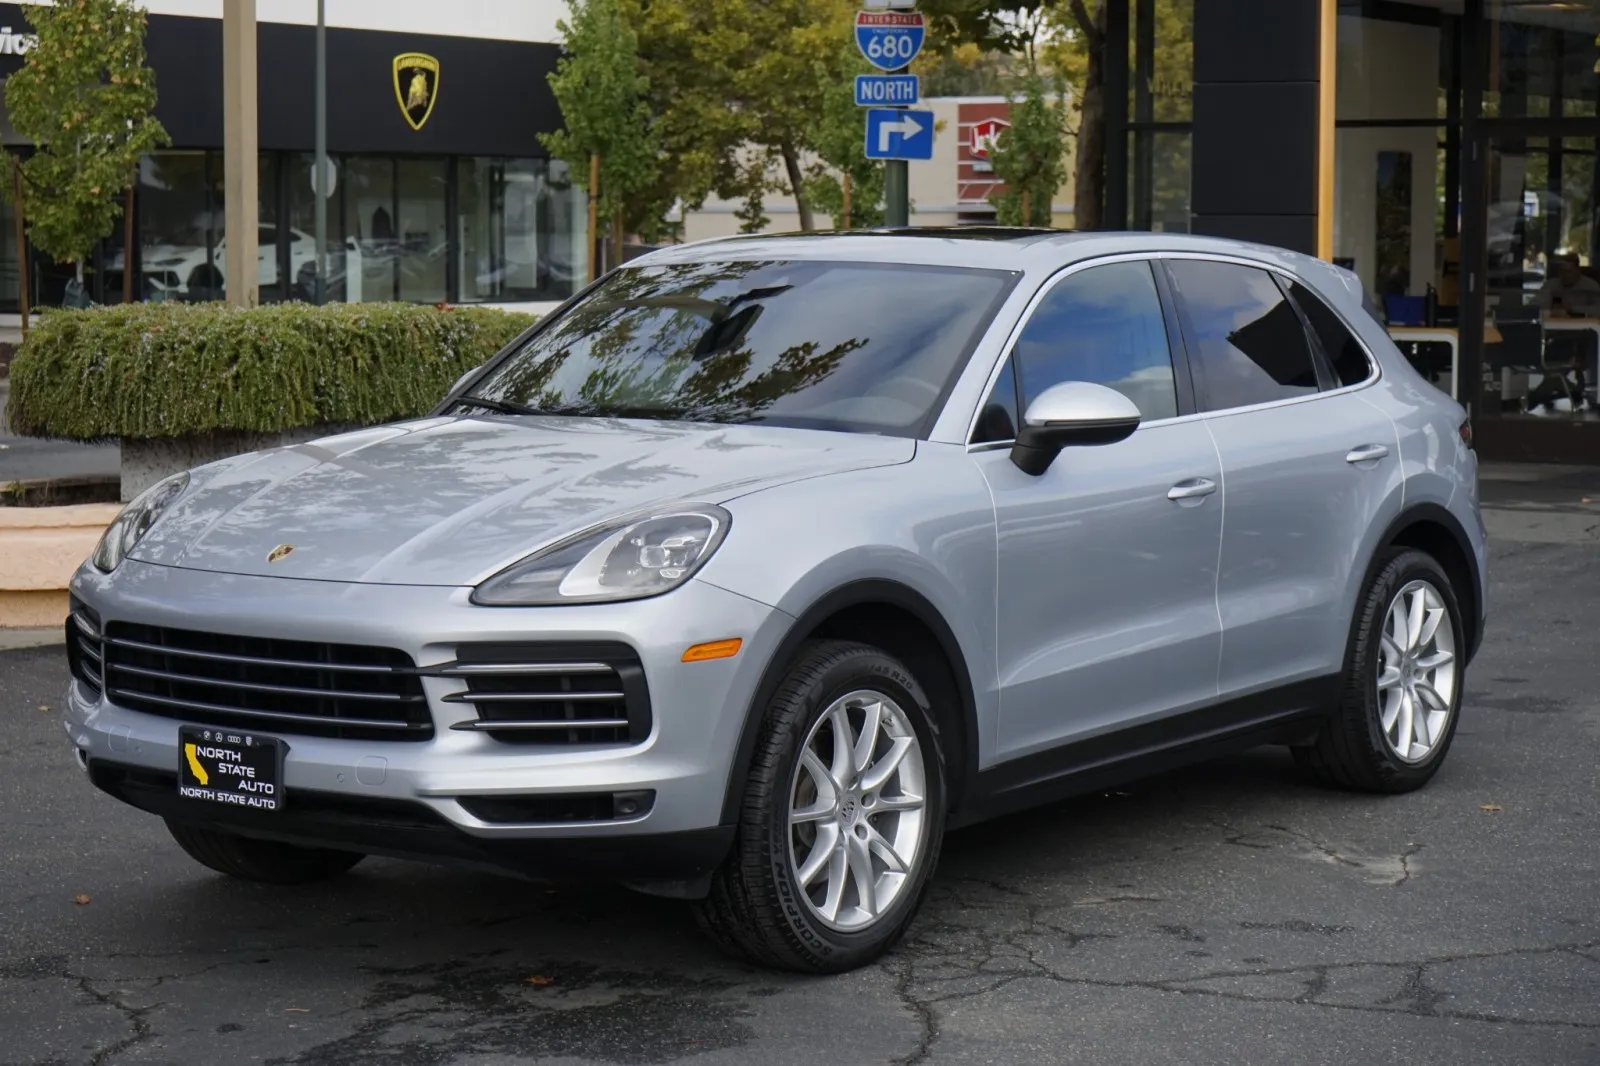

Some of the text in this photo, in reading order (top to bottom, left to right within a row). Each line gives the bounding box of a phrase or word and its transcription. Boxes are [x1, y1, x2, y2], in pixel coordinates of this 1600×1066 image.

[863, 14, 917, 25] INTERSTATE
[868, 35, 913, 58] 680
[861, 81, 914, 100] NORTH
[197, 746, 241, 762] NORTH
[218, 762, 255, 778] STATE
[238, 780, 274, 794] AUTO
[180, 786, 275, 809] NORTH STATE AUTO
[775, 863, 833, 957] SCORPION
